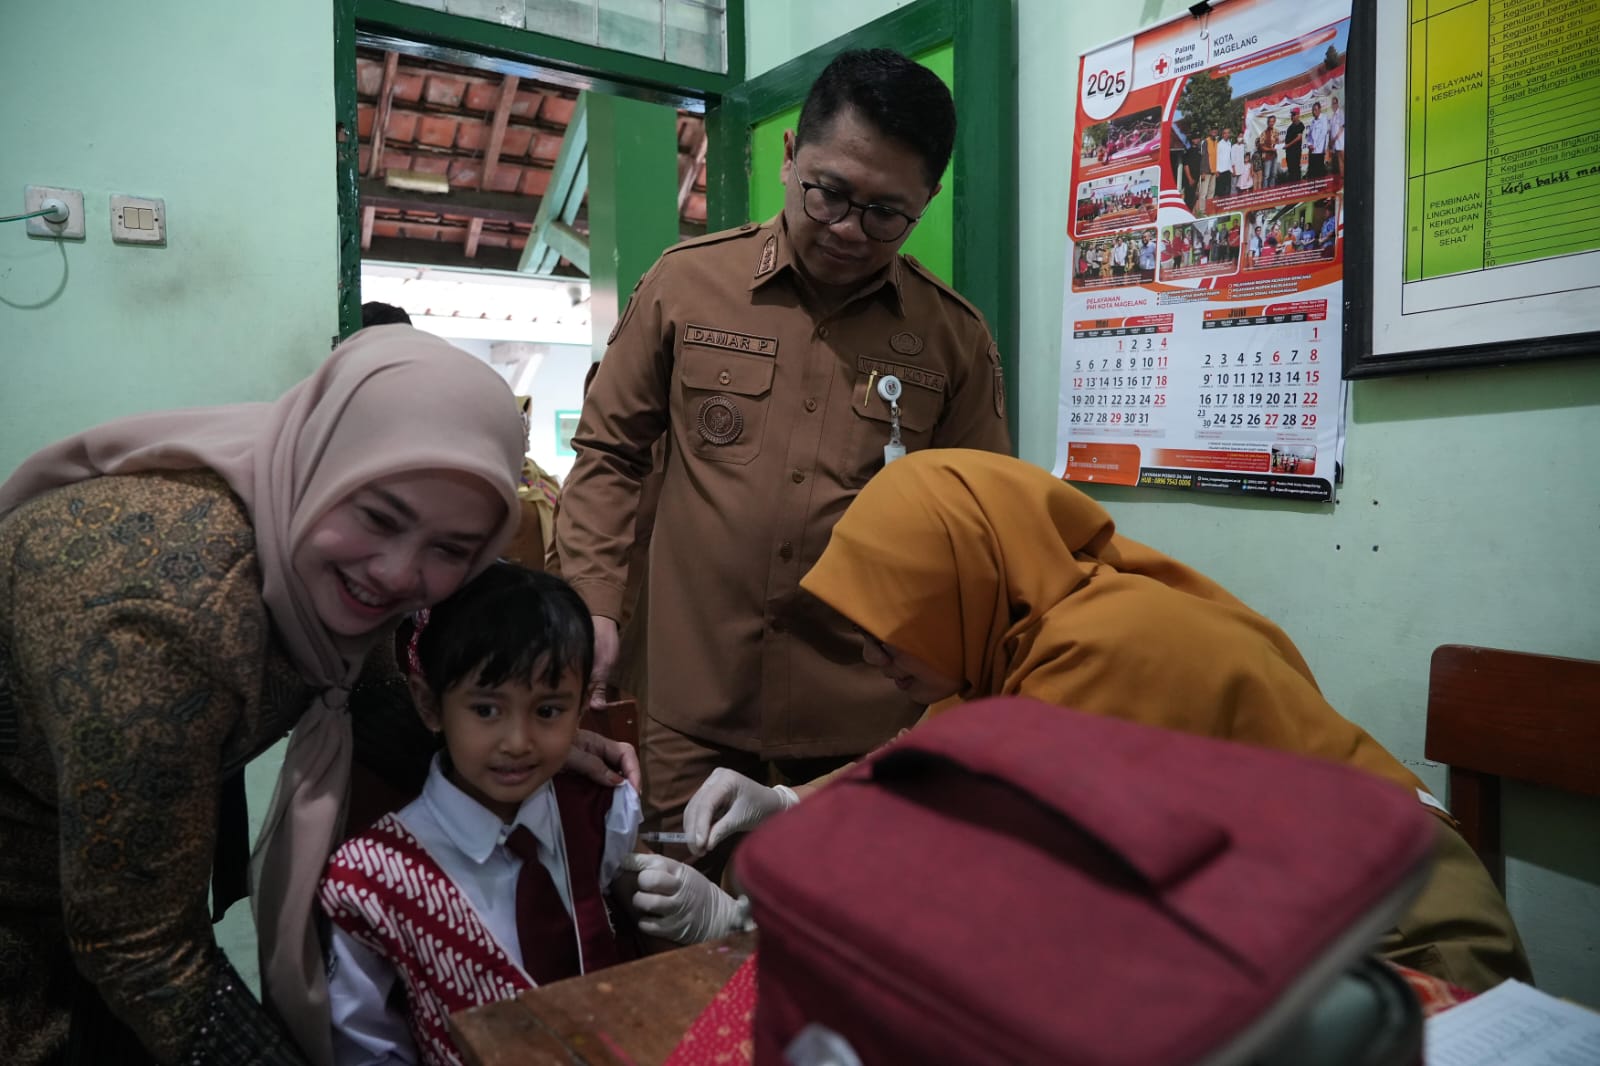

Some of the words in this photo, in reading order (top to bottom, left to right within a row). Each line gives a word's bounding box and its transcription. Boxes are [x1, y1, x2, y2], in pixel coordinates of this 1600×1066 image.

[1504, 2, 1540, 19] Kegiatan
[1504, 9, 1545, 31] penularan
[1214, 34, 1234, 46] KOTA
[1503, 24, 1540, 40] Kegiatan
[1503, 33, 1538, 52] penyakit
[1540, 25, 1564, 38] tahap
[1567, 18, 1583, 29] dini
[1175, 43, 1196, 56] Palang
[1214, 36, 1258, 58] MAGELANG
[1503, 37, 1564, 61] Penyembuhan
[1567, 30, 1583, 40] dan
[1174, 60, 1204, 74] Indonesia
[1175, 54, 1193, 65] Merah
[1503, 58, 1527, 72] akibat
[1530, 49, 1559, 65] proses
[1503, 60, 1555, 80] Peningkatan
[1087, 70, 1126, 98] 2025
[1432, 71, 1483, 92] PELAYANAN
[1503, 81, 1521, 93] didik
[1527, 74, 1547, 87] yang
[1550, 64, 1577, 77] cidera
[1432, 82, 1483, 103] KESEHATAN
[1503, 90, 1525, 102] dapat
[1528, 77, 1568, 96] berfungsi
[1502, 149, 1538, 164] Kegiatan
[1540, 144, 1559, 154] bina
[1561, 134, 1600, 148] lingkung
[1501, 160, 1538, 174] Kegiatan
[1540, 154, 1559, 164] bina
[1561, 144, 1600, 159] lingkung
[1501, 173, 1524, 183] sosial
[1502, 181, 1532, 196] Kerja
[1537, 171, 1569, 188] bakti
[1430, 192, 1481, 209] PEMBINAAN
[1427, 202, 1483, 220] LINGKUNGAN
[1430, 213, 1479, 229] KEHIDUPAN
[1434, 224, 1474, 238] SEKOLAH
[1440, 235, 1467, 247] SEHAT
[1087, 296, 1120, 305] PELAYANAN
[1114, 299, 1148, 308] MAGELANG
[693, 330, 750, 350] DAMAR
[758, 339, 769, 351] P
[1313, 328, 1318, 339] 1
[1119, 341, 1123, 350] 1
[1131, 340, 1137, 350] 2
[1146, 339, 1152, 349] 3
[1161, 338, 1167, 348] 4
[1076, 361, 1081, 370] 5
[1089, 360, 1094, 369] 6
[1102, 360, 1108, 369] 7
[1116, 359, 1122, 368] 8
[1130, 358, 1136, 368] 9
[1143, 357, 1153, 367] 10
[1158, 357, 1168, 367] 11
[1205, 355, 1211, 365] 2
[1221, 354, 1227, 364] 3
[1238, 353, 1244, 364] 4
[1255, 352, 1262, 363] 5
[1273, 351, 1280, 362] 6
[1292, 350, 1299, 361] 7
[1310, 349, 1318, 361] 8
[904, 367, 943, 388] KOTA
[1073, 378, 1082, 387] 12
[1087, 378, 1096, 387] 13
[1100, 378, 1109, 387] 14
[1113, 377, 1123, 386] 15
[1127, 377, 1137, 386] 16
[1142, 376, 1152, 386] 17
[1157, 376, 1167, 386] 18
[1204, 374, 1210, 385] 9
[1218, 374, 1229, 384] 10
[1234, 373, 1245, 384] 11
[1251, 373, 1264, 383] 12
[1269, 372, 1281, 383] 13
[1287, 371, 1300, 383] 14
[1306, 371, 1320, 383] 15
[1072, 395, 1081, 405] 19
[1085, 395, 1094, 405] 20
[1098, 395, 1107, 404] 21
[1111, 395, 1122, 405] 22
[1125, 395, 1136, 405] 23
[1139, 395, 1150, 404] 24
[1154, 395, 1166, 404] 25
[1200, 394, 1211, 405] 16
[1216, 394, 1228, 405] 17
[1233, 394, 1245, 404] 18
[1250, 393, 1262, 404] 19
[1266, 393, 1280, 404] 20
[1284, 393, 1297, 404] 21
[1303, 393, 1318, 404] 22
[1071, 413, 1081, 422] 26
[1084, 413, 1093, 422] 27
[1097, 413, 1107, 423] 28
[1110, 413, 1121, 423] 29
[1124, 413, 1135, 423] 30
[1138, 413, 1149, 423] 31
[1214, 414, 1226, 425] 24
[1230, 414, 1243, 425] 25
[1248, 414, 1261, 425] 26
[1265, 414, 1279, 425] 27
[1283, 415, 1297, 425] 28
[1302, 415, 1317, 426] 29
